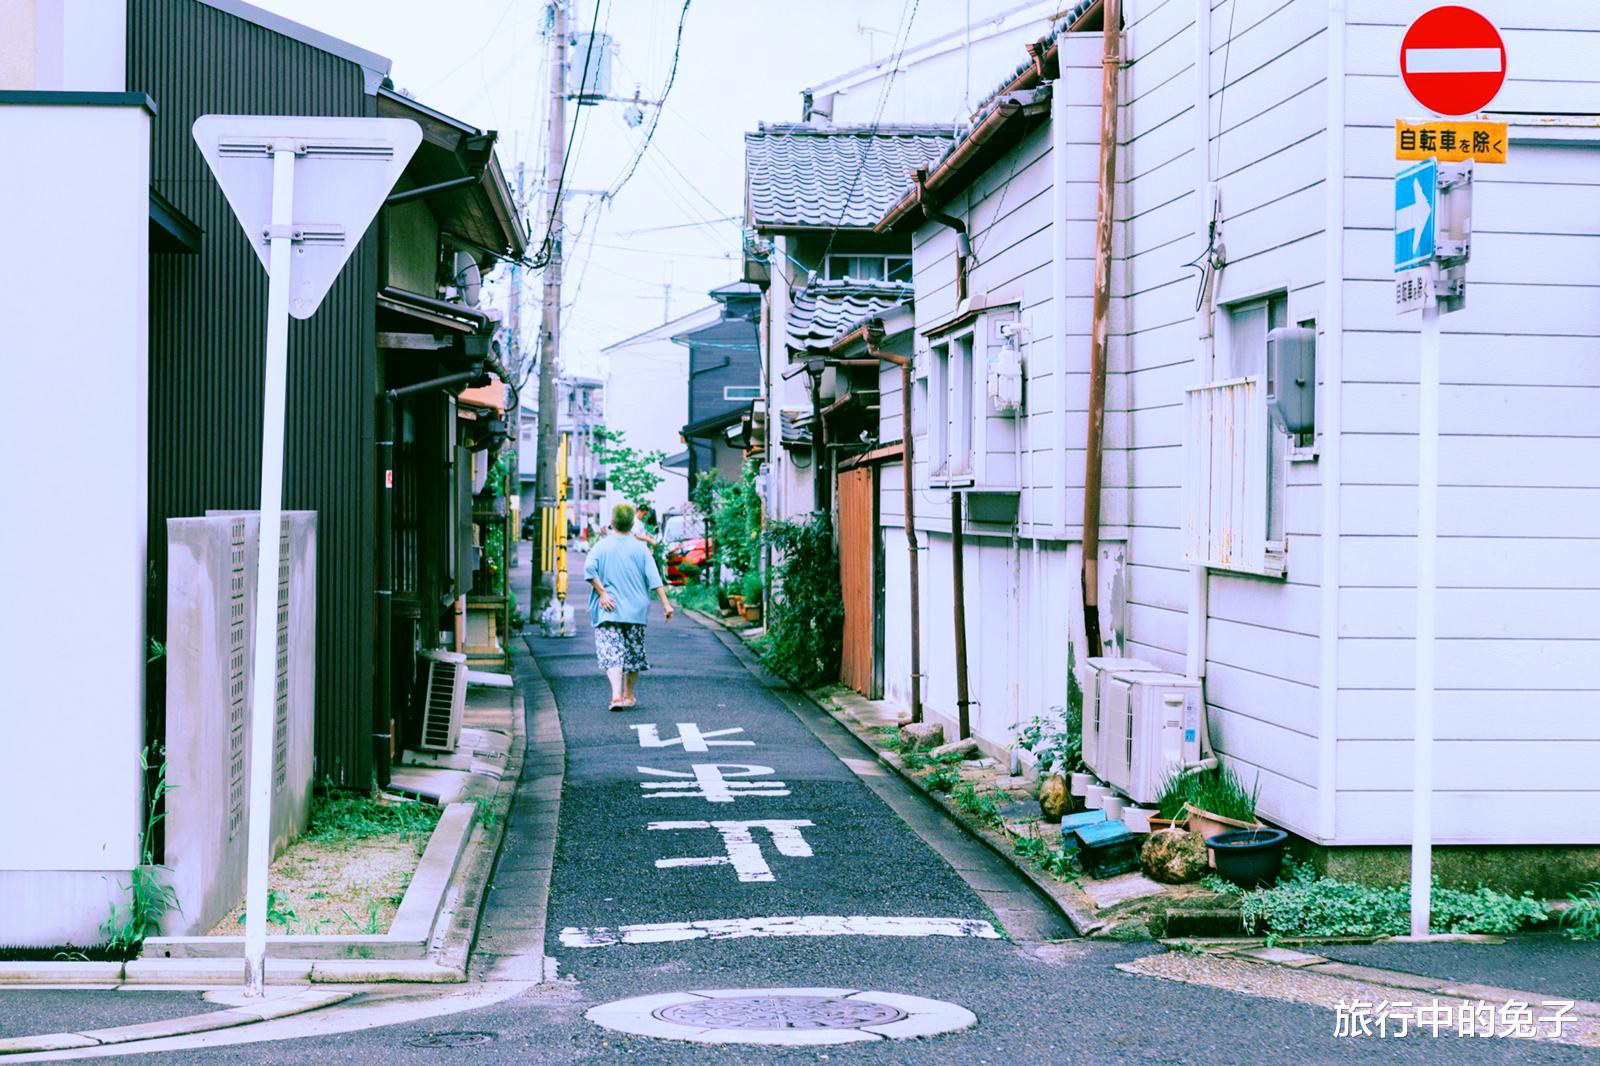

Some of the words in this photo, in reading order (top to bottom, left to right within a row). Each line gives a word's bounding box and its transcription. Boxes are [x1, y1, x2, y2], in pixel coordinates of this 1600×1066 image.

[1400, 128, 1503, 154] 自転車を除く
[629, 723, 816, 882] 止まれ
